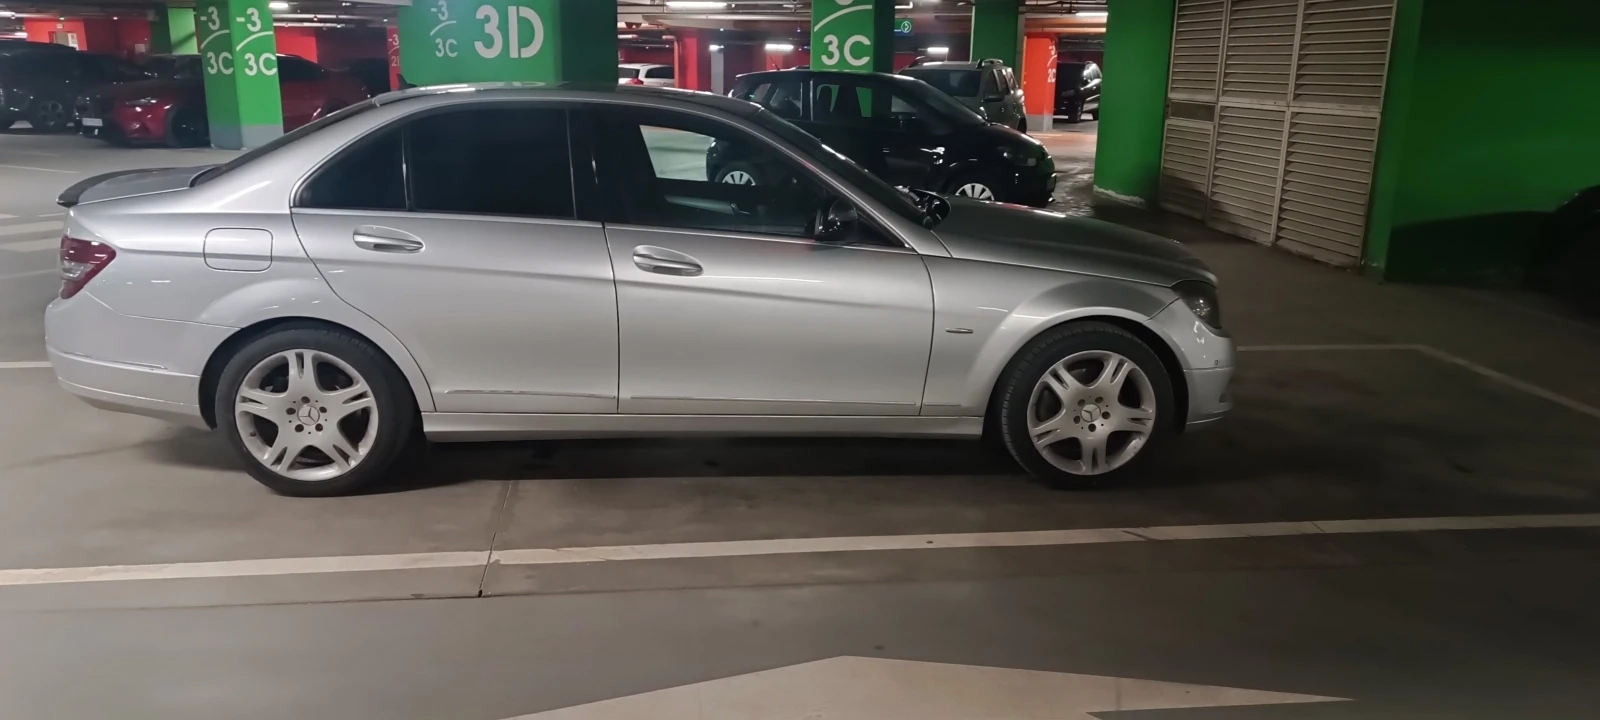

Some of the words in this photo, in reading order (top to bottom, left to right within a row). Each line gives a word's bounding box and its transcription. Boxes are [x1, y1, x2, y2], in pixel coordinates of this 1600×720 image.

[200, 6, 220, 30] -3
[236, 7, 262, 32] -3
[431, 0, 449, 21] -3
[388, 33, 399, 46] -3
[474, 4, 544, 58] 3D
[435, 38, 458, 58] 3C
[821, 34, 871, 66] 3C
[207, 51, 234, 75] 3C
[244, 52, 277, 76] 3C
